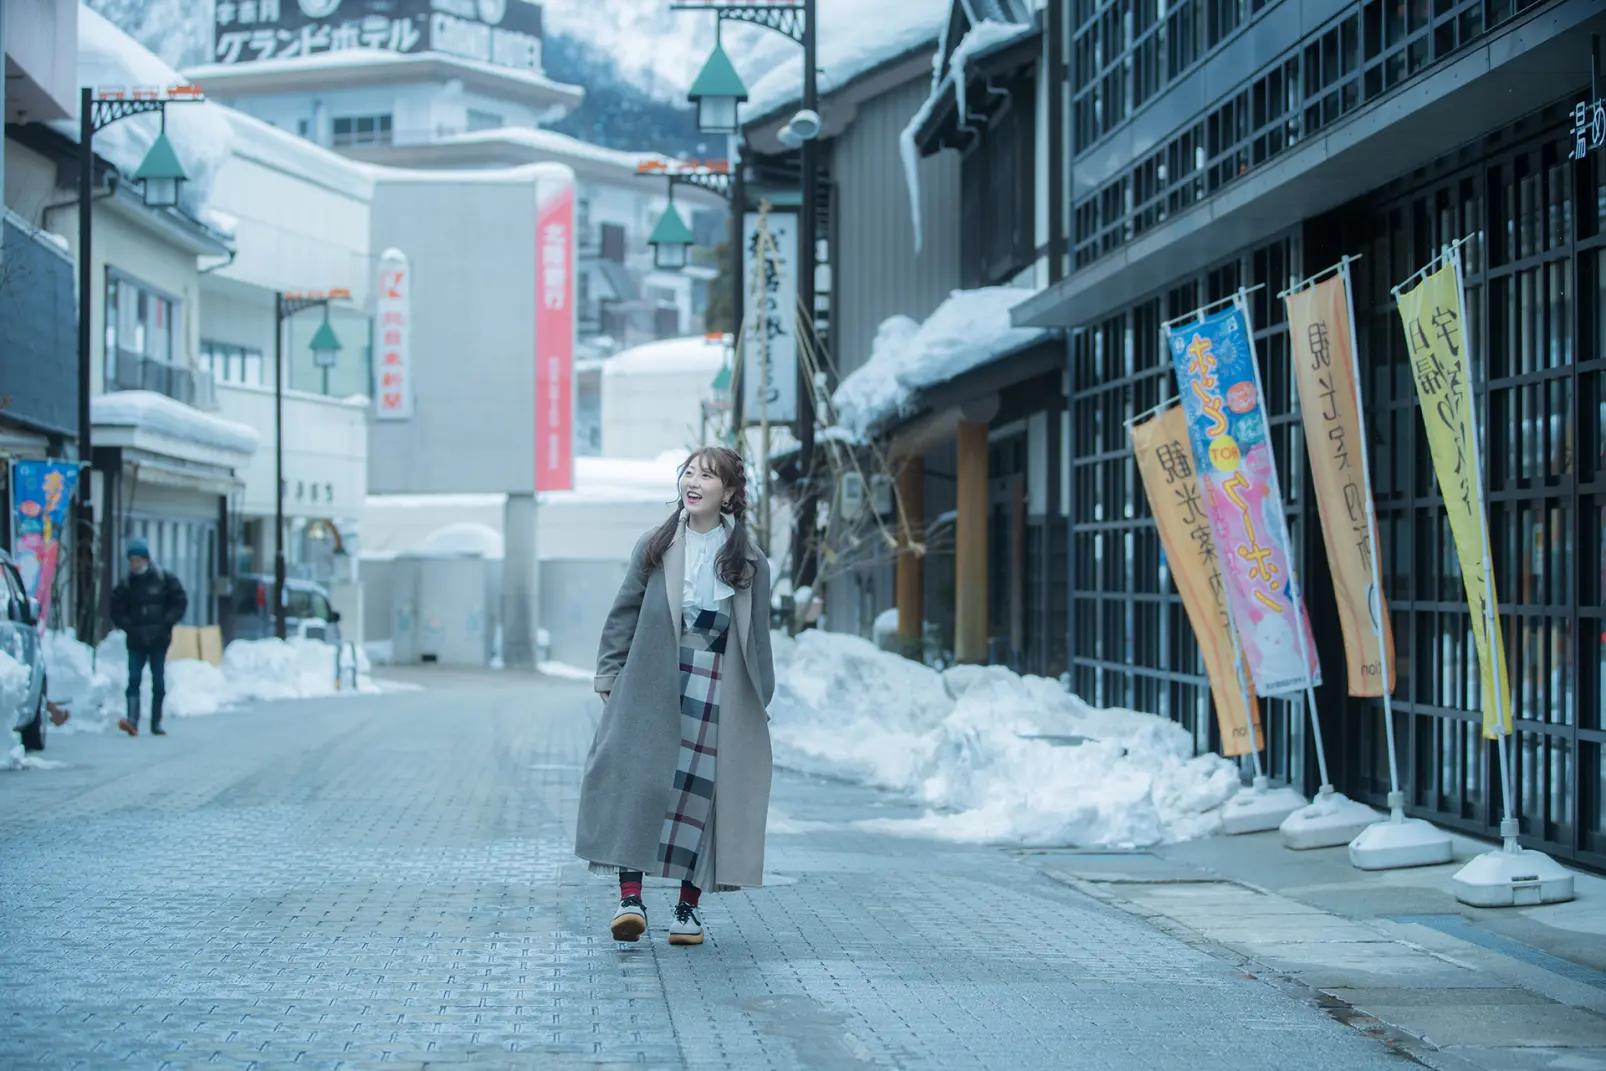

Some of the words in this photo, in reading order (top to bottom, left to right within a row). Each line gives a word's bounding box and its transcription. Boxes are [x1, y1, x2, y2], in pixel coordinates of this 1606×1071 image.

[216, 16, 421, 63] グランドホテル
